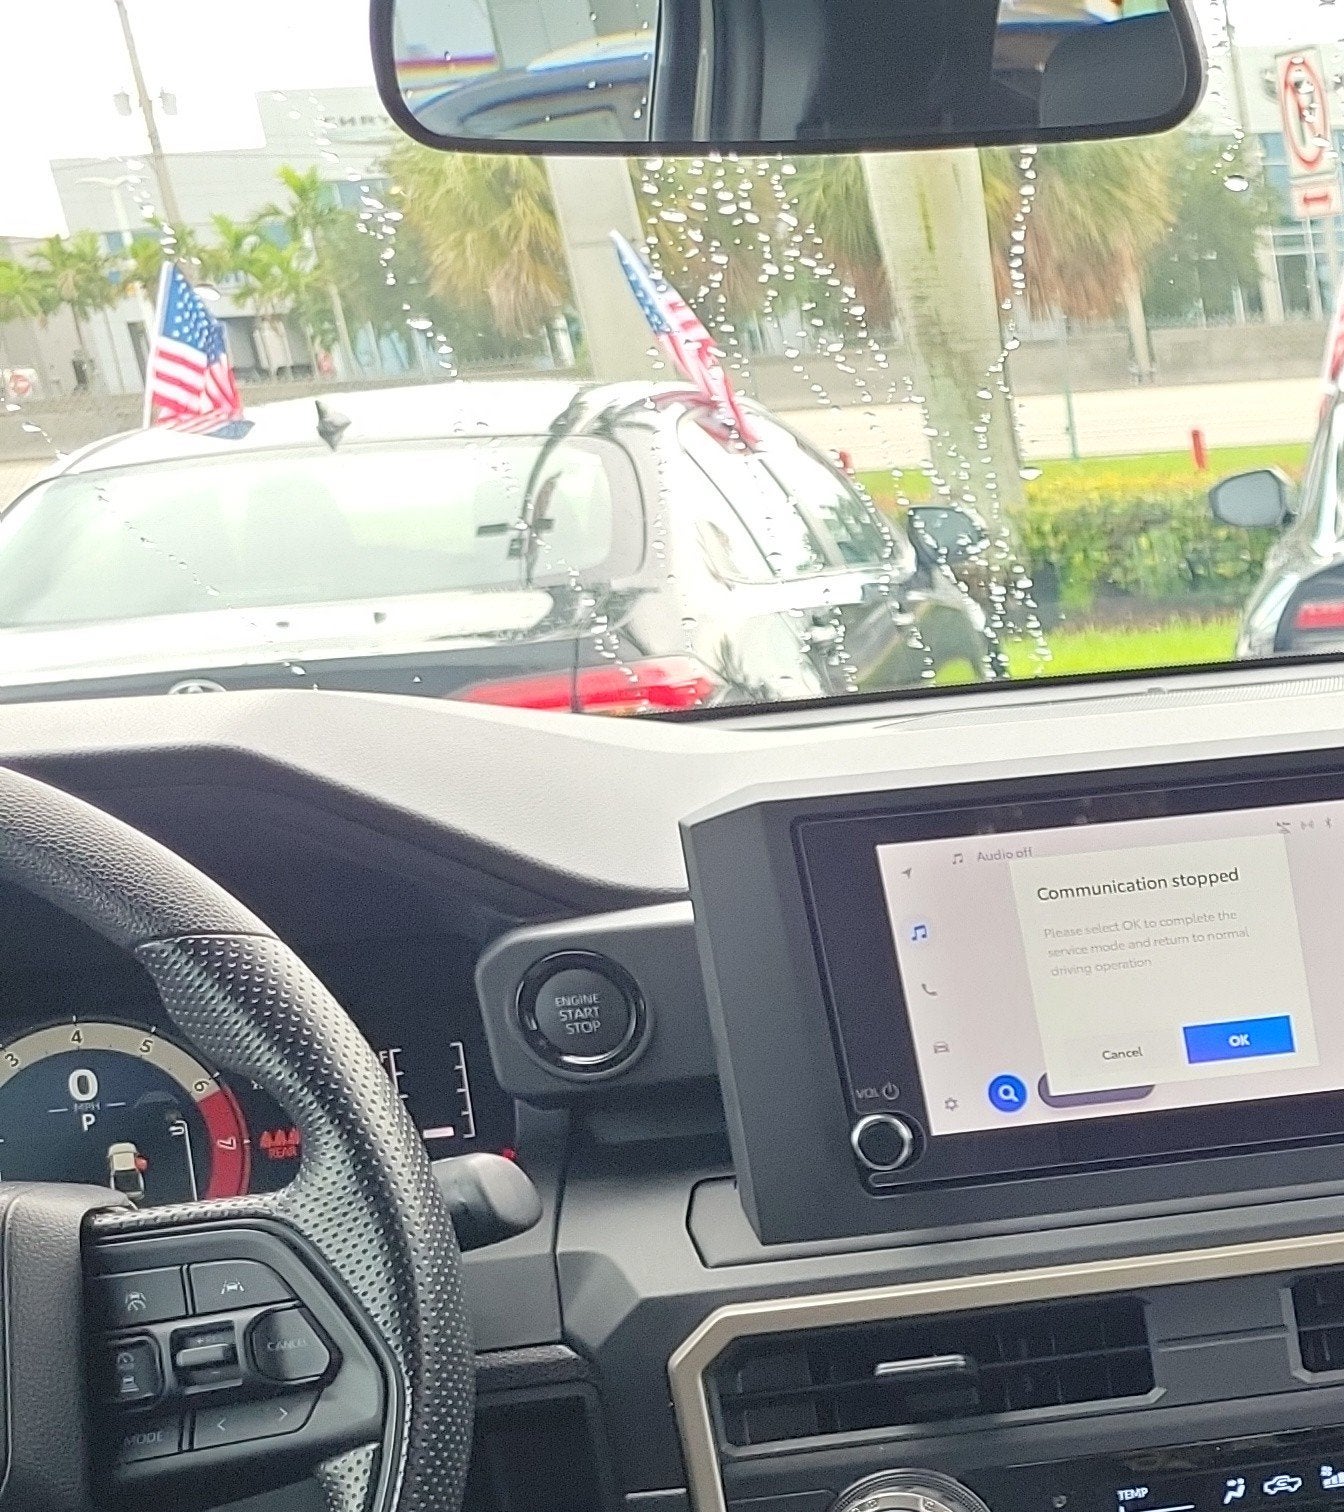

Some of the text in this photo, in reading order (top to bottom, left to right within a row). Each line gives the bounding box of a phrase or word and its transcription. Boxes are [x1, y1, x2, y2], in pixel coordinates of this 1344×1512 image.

[977, 847, 1033, 862] Audio off
[1037, 867, 1239, 901] Communication stopped
[1044, 910, 1237, 938] Please select OK to complete the
[1048, 926, 1250, 958] service mode and return to normal
[1051, 958, 1152, 977] driving operation
[555, 993, 600, 1007] ENGINE
[560, 1006, 600, 1021] START
[566, 1020, 601, 1034] STOP
[71, 1029, 83, 1044] 4
[1228, 1033, 1250, 1047] OK
[139, 1039, 153, 1053] 5
[1102, 1046, 1144, 1060] Cancel
[5, 1053, 19, 1067] 3
[379, 1050, 388, 1063] F
[68, 1068, 98, 1101] 0
[194, 1079, 209, 1093] 6
[82, 1113, 96, 1131] P
[217, 1136, 237, 1150] 7
[123, 1431, 164, 1446] MODE
[1117, 1487, 1149, 1501] TEMP
